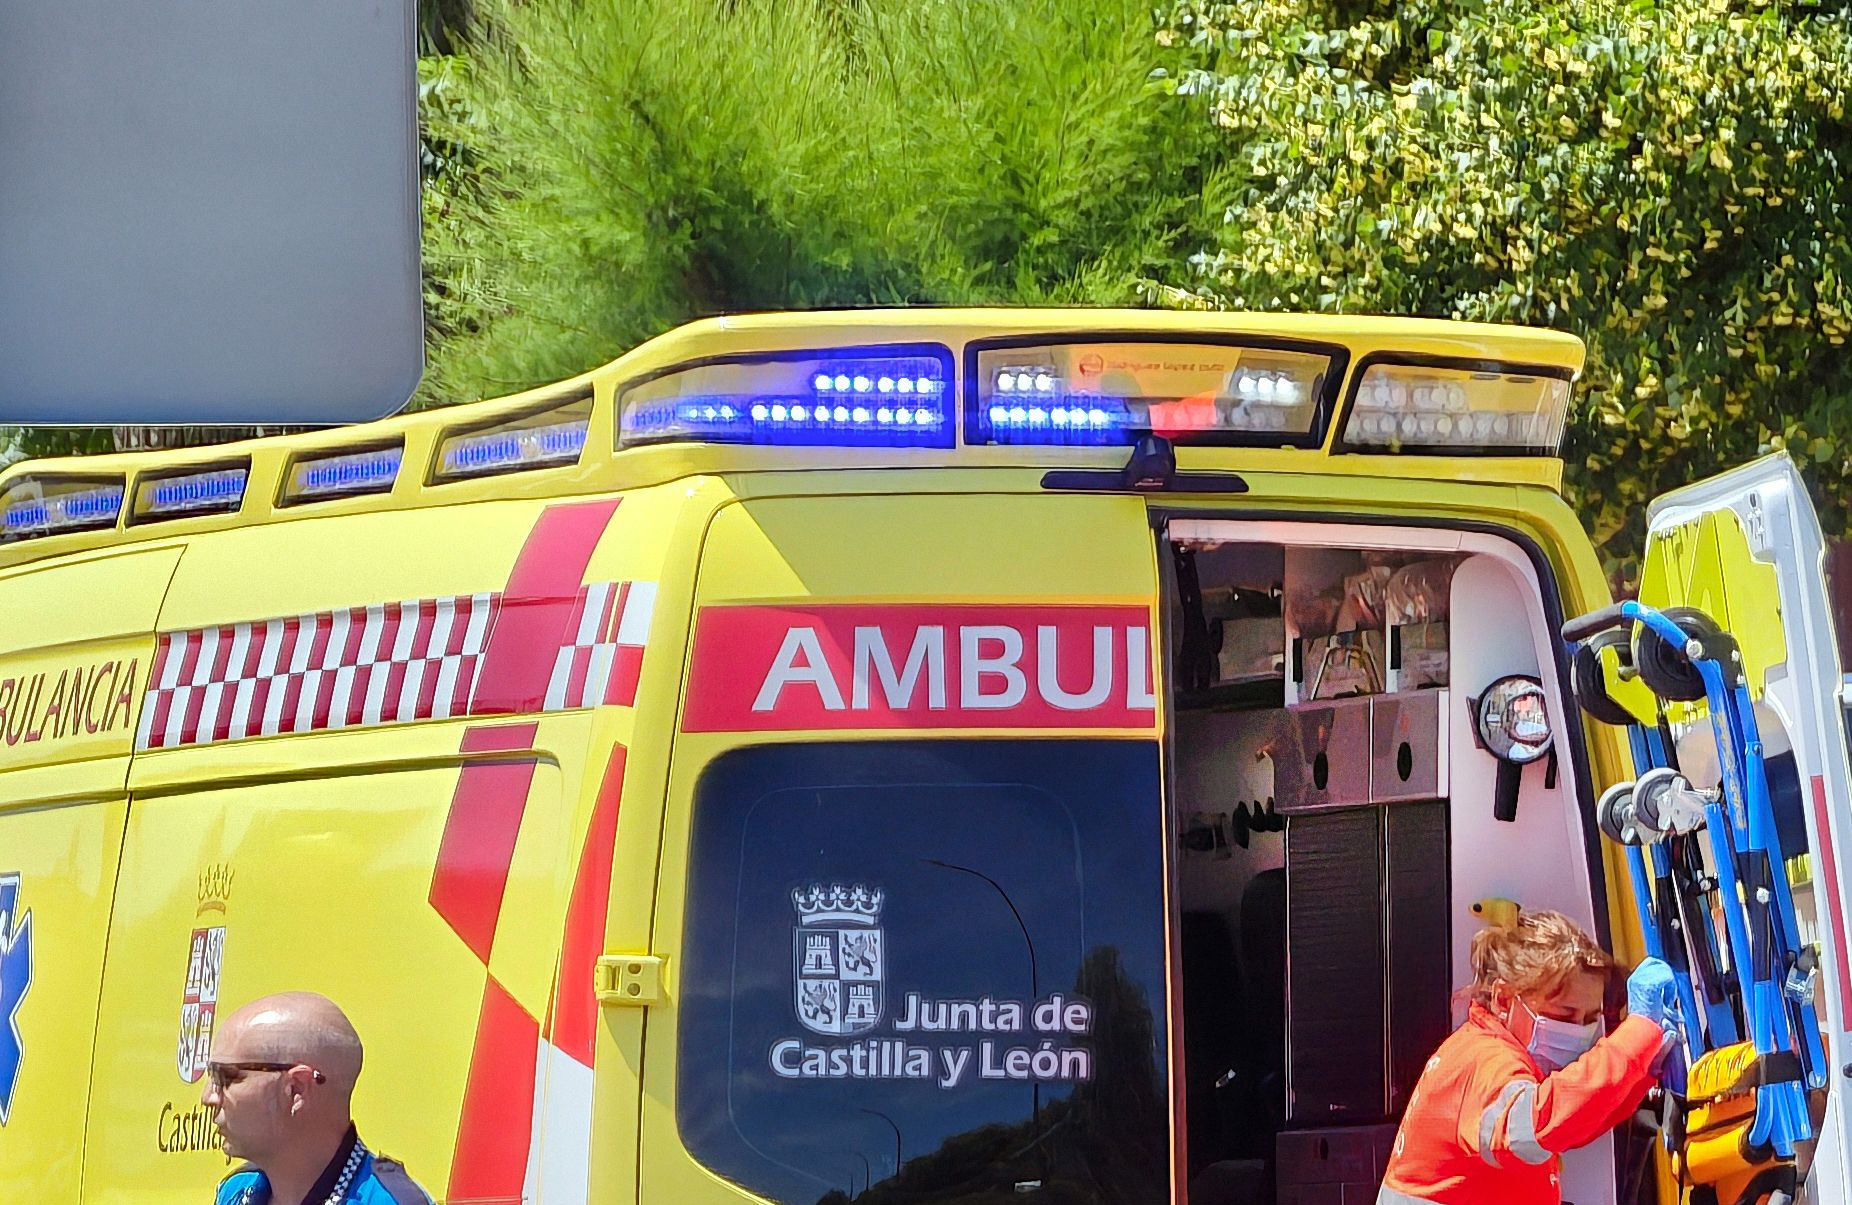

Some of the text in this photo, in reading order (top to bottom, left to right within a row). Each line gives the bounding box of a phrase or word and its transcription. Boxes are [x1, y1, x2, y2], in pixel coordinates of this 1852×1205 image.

[751, 625, 1155, 711] AMBUL
[895, 993, 1089, 1032] Junta de
[770, 1039, 1089, 1088] Castilla y León
